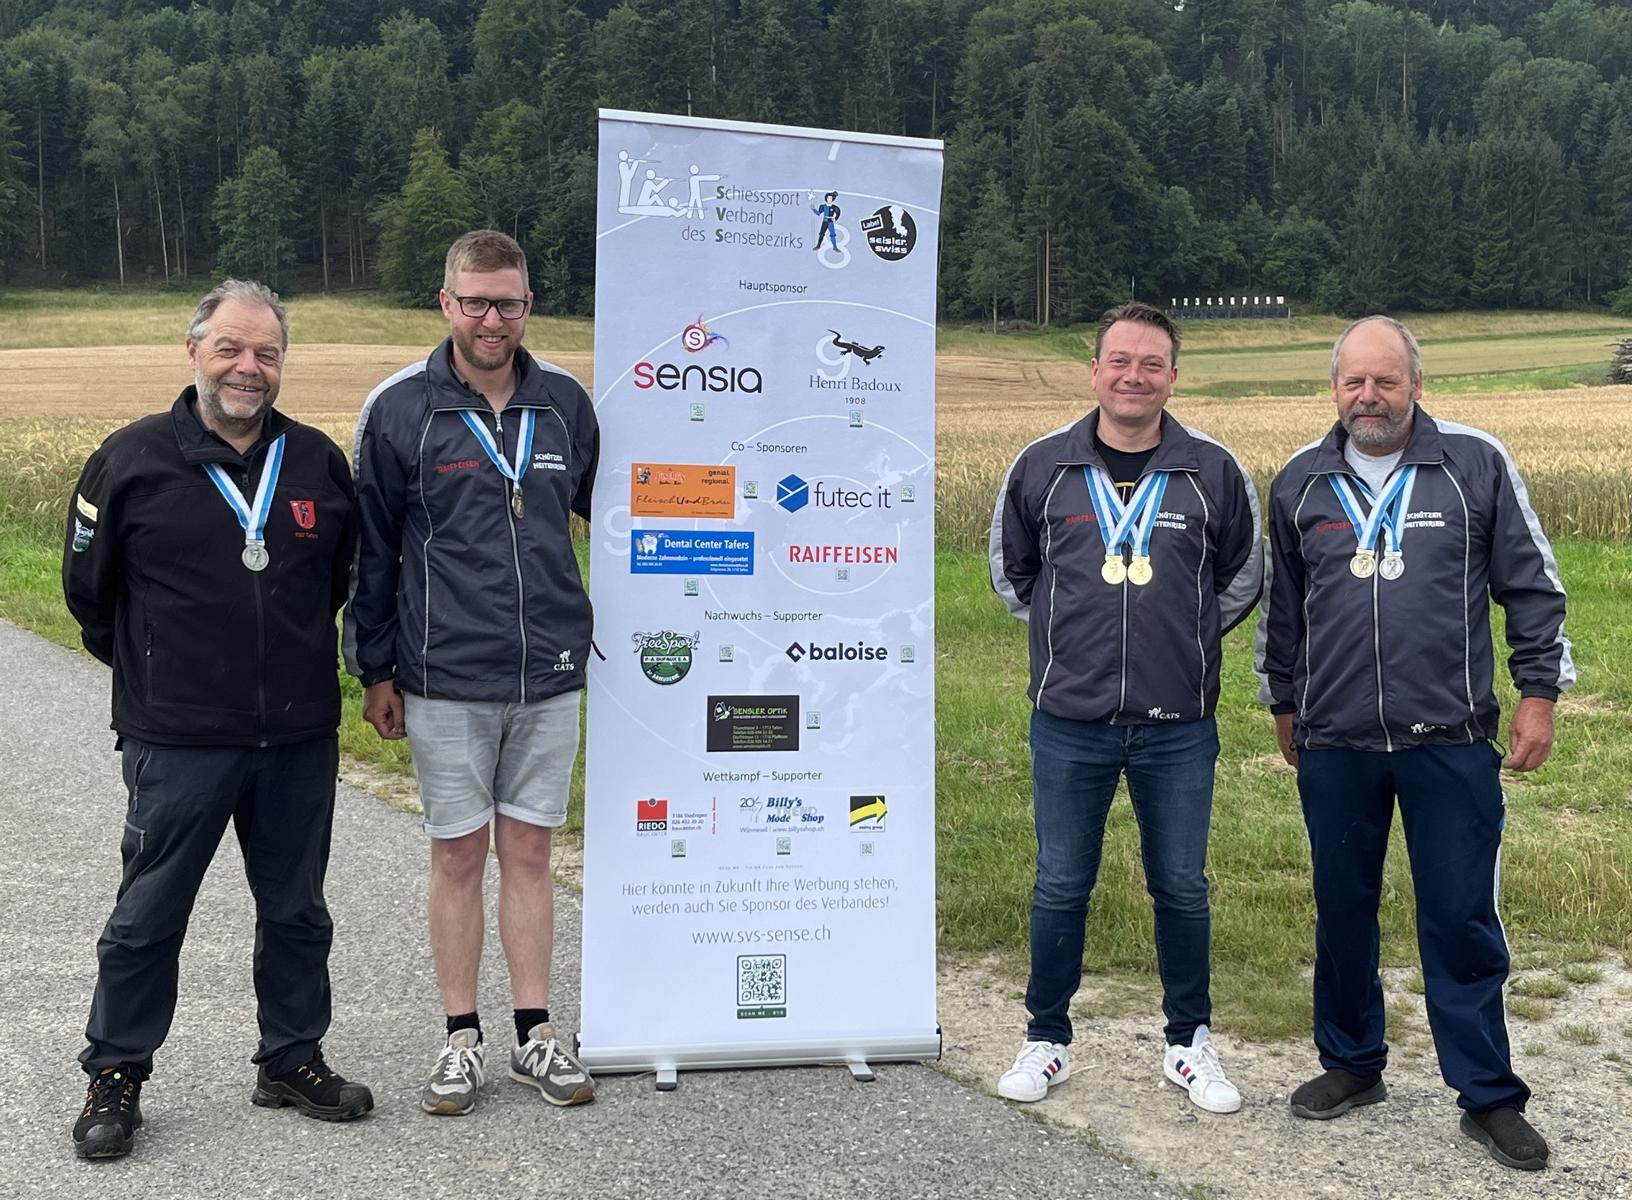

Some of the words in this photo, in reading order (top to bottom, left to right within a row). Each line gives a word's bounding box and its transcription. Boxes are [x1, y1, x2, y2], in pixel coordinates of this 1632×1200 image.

[716, 185, 801, 206] Schiesssport
[716, 207, 774, 225] Verband
[862, 218, 880, 229] Label
[681, 225, 706, 242] des
[715, 228, 803, 249] Sensebezirks
[875, 245, 908, 254] swiss
[739, 280, 808, 294] Hauptsponsor
[1172, 297, 1176, 306] 1
[1183, 297, 1188, 306] 2
[1195, 297, 1200, 306] 3
[1206, 297, 1212, 306] 4
[1218, 297, 1223, 306] 5
[1230, 297, 1235, 305] 6
[1242, 296, 1247, 305] 7
[1276, 296, 1285, 305] 10
[809, 375, 847, 389] Henri
[851, 377, 902, 392] Badoux
[845, 396, 866, 405] 1908
[731, 441, 745, 452] Co
[756, 442, 808, 454] Sponsoren
[814, 482, 872, 508] futec
[878, 485, 892, 508] it
[1155, 511, 1185, 521] CHÜTZEN
[664, 539, 693, 549] Dental
[694, 540, 723, 550] Center
[725, 540, 750, 550] Tafers
[789, 545, 898, 564] RAIFFEISEN
[704, 610, 763, 621] Nachwuchs
[773, 610, 823, 624] Supporter
[810, 641, 889, 661] baloise
[553, 663, 575, 671] CATS
[733, 707, 766, 715] SENSLER
[703, 771, 761, 783] Wettkampf
[771, 771, 823, 783] Supporter
[766, 797, 803, 809] Billy's
[766, 814, 791, 823] Mode
[801, 814, 825, 824] Shop
[638, 822, 666, 830] RIEDO
[622, 882, 647, 896] Hier
[699, 882, 711, 893] in
[715, 878, 762, 894] Zukunft
[766, 878, 790, 892] Ihre
[794, 876, 849, 894] Werbung
[853, 876, 899, 891] stehen,
[632, 900, 680, 915] werden
[684, 899, 714, 913] auch
[718, 899, 737, 912] Sie
[741, 897, 790, 914] Sponsor
[795, 896, 817, 910] des
[821, 895, 889, 910] Verbandes!
[692, 924, 831, 944] www.svs-sense.ch
